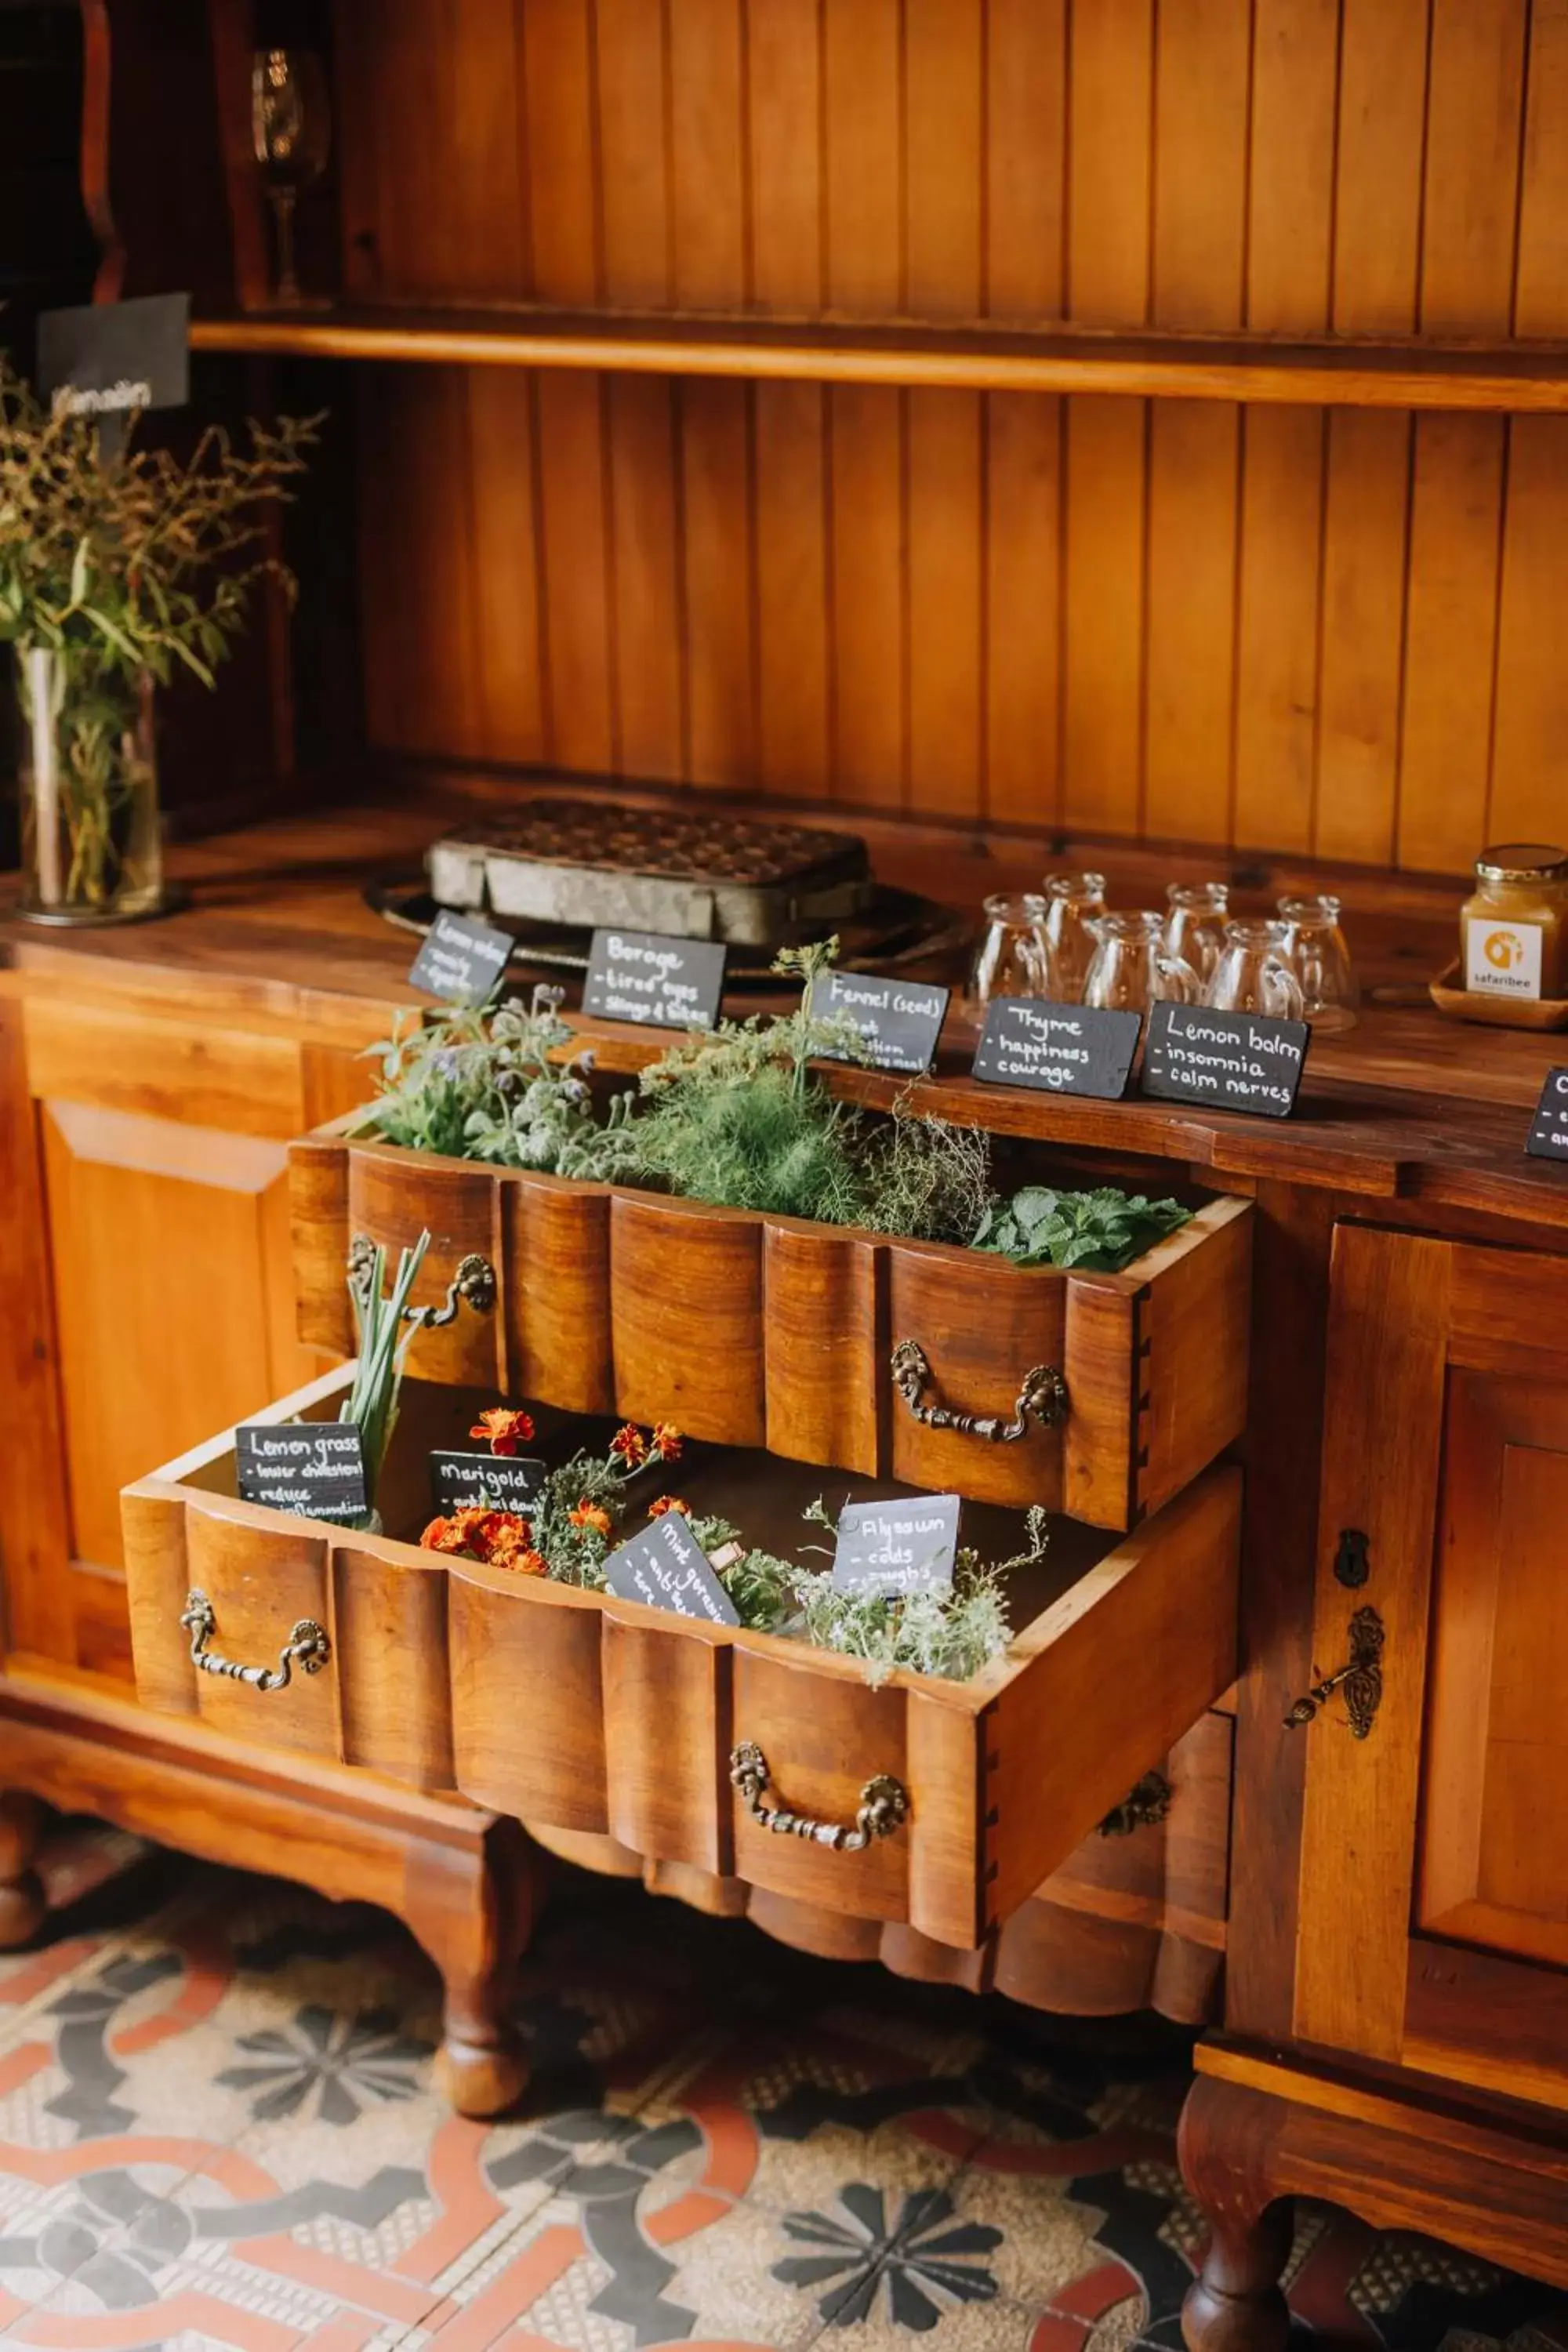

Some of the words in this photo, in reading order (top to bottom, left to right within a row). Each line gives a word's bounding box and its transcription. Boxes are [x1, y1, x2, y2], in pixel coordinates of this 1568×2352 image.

[608, 935, 684, 981] Borage
[829, 978, 890, 1008] Fennel
[1007, 1006, 1083, 1041] Thyme
[1167, 1010, 1241, 1045] Lemon
[1248, 1026, 1301, 1062] balm
[1000, 1035, 1089, 1063] happiness
[1166, 1042, 1266, 1078] insomnia
[997, 1060, 1075, 1087] courage
[1171, 1067, 1218, 1090] calm
[1225, 1079, 1291, 1104] nerves
[250, 1432, 311, 1457] Lemon
[314, 1437, 360, 1467] grass
[256, 1462, 296, 1478] lower
[440, 1464, 529, 1497] Marigold
[260, 1486, 312, 1502] reduce
[662, 1523, 691, 1565] Mint
